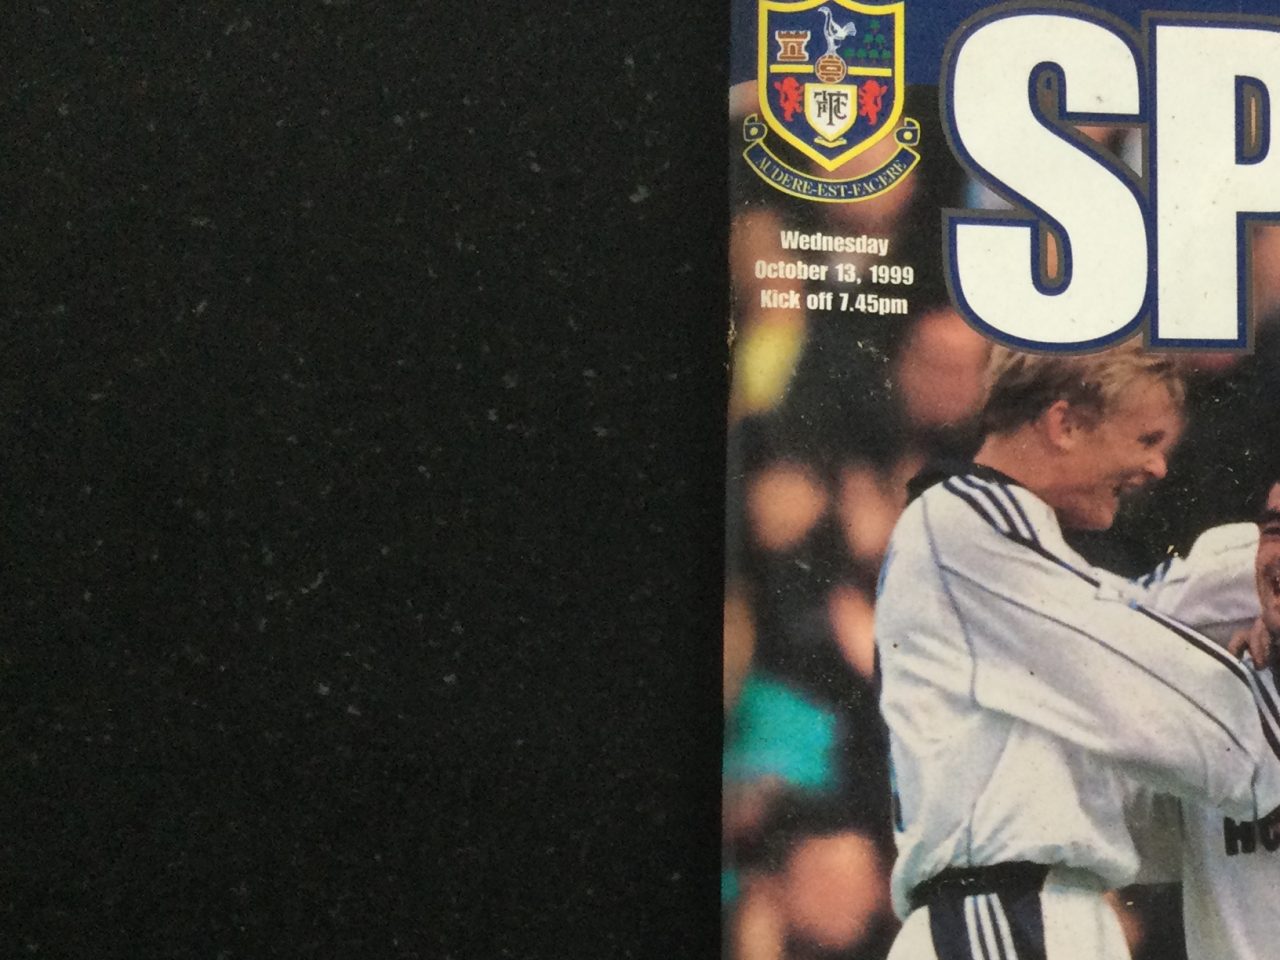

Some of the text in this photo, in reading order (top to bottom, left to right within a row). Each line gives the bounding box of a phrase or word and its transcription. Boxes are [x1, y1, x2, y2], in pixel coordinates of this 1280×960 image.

[780, 231, 889, 256] Wednesday
[754, 260, 915, 286] October 13, 1999
[760, 289, 909, 316] Kick off 7.45pm
